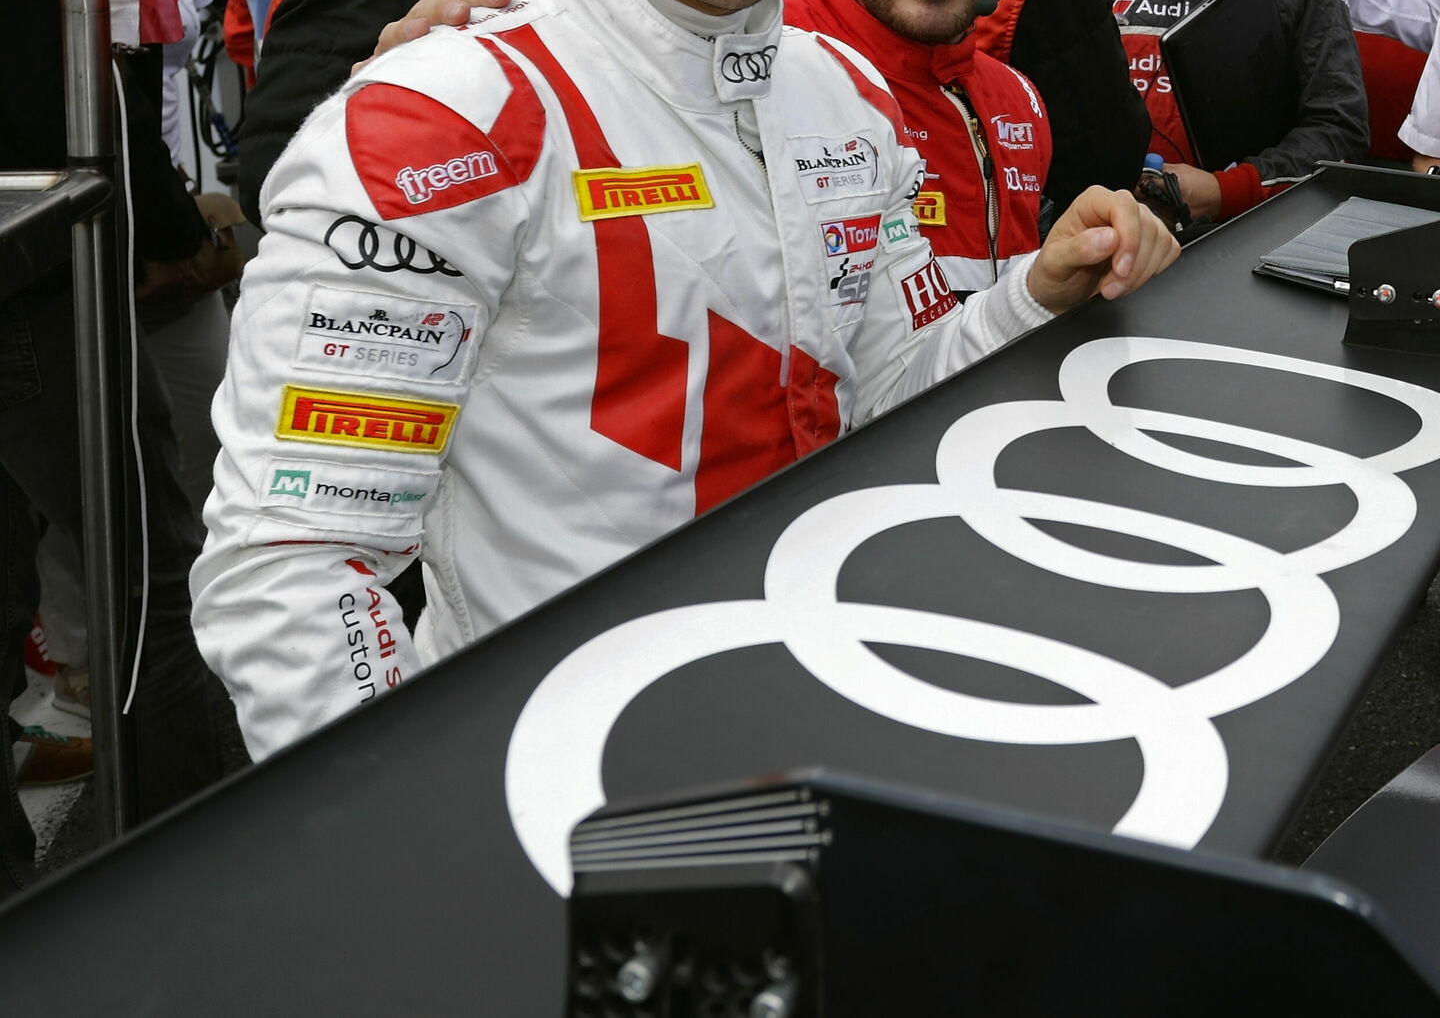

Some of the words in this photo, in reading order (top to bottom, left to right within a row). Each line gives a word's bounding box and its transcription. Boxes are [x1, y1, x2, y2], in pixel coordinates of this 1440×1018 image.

[1135, 0, 1190, 18] Audi
[1129, 54, 1162, 72] udi
[795, 151, 867, 172] BLANCPAIN
[397, 152, 497, 204] freem
[588, 173, 700, 211] PIRELLI
[816, 176, 830, 189] GT
[845, 224, 878, 245] TOTAL
[904, 260, 951, 316] HO
[309, 312, 446, 345] BLANCPAIN
[323, 342, 350, 359] GT
[354, 347, 419, 367] SERIES
[290, 396, 446, 445] PIRELLI
[366, 587, 396, 660] Audi
